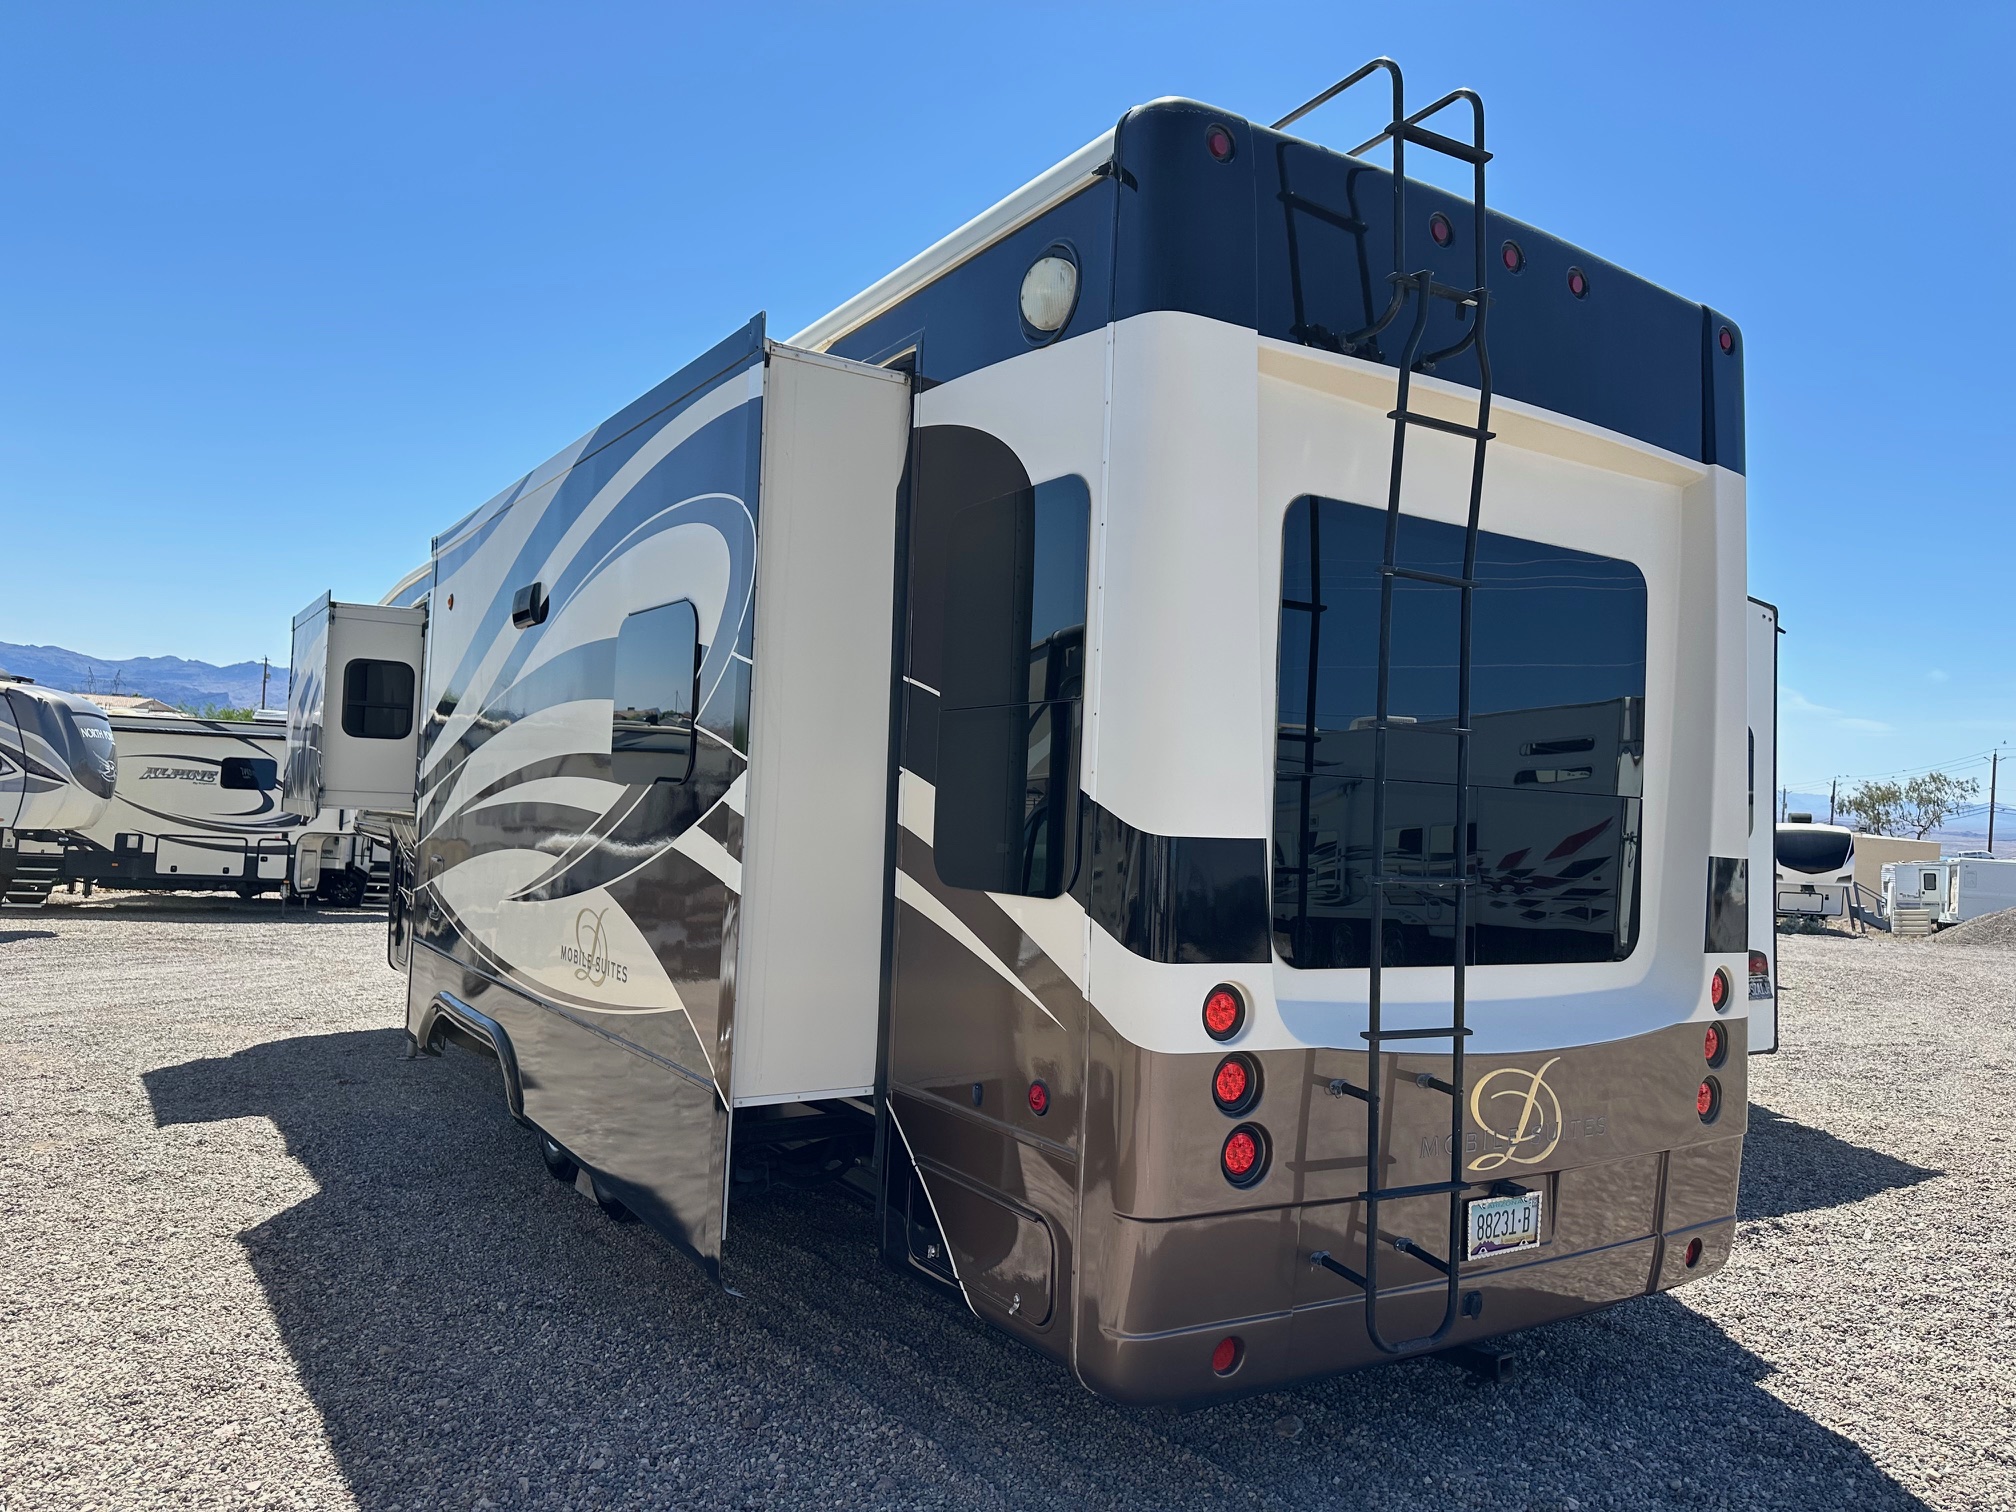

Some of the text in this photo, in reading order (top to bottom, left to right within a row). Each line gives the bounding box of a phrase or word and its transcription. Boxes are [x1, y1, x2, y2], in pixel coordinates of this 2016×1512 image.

[80, 727, 104, 739] NORTH
[139, 766, 219, 783] ALPINE
[560, 944, 629, 984] MOBILE SUITES
[1530, 1116, 1608, 1146] SUITES
